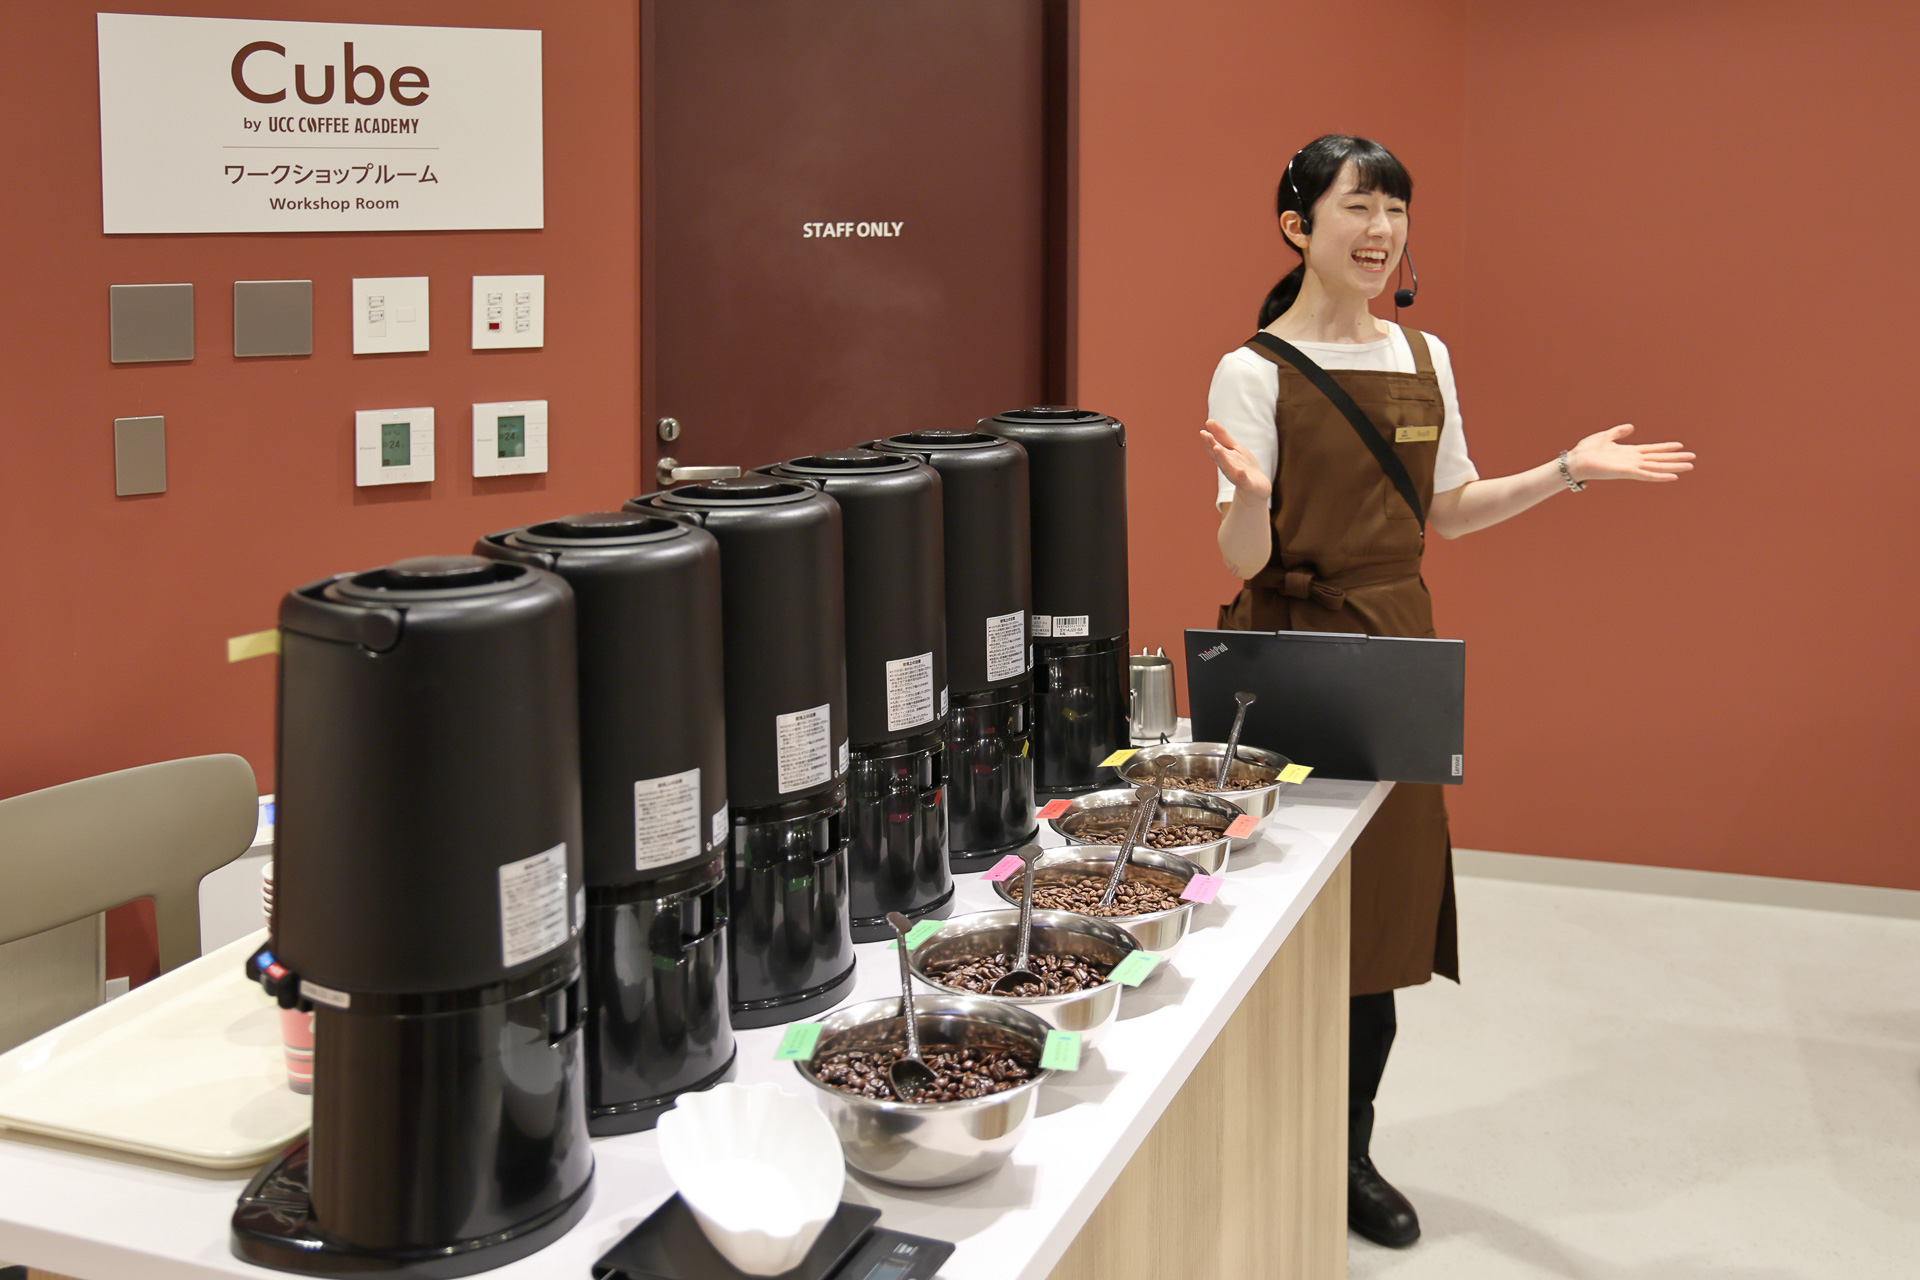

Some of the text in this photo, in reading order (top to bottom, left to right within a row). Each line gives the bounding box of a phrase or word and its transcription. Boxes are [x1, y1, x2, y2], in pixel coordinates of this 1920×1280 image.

[231, 41, 429, 106] Cube
[243, 116, 420, 134] by UCC COFFEE ACADEMY
[224, 162, 439, 185] ワークショップルーム
[269, 196, 399, 213] Workshop Room
[802, 221, 904, 238] STAFF ONLY
[389, 440, 400, 449] 24
[504, 432, 515, 441] 24
[1198, 642, 1228, 662] ThinkPad
